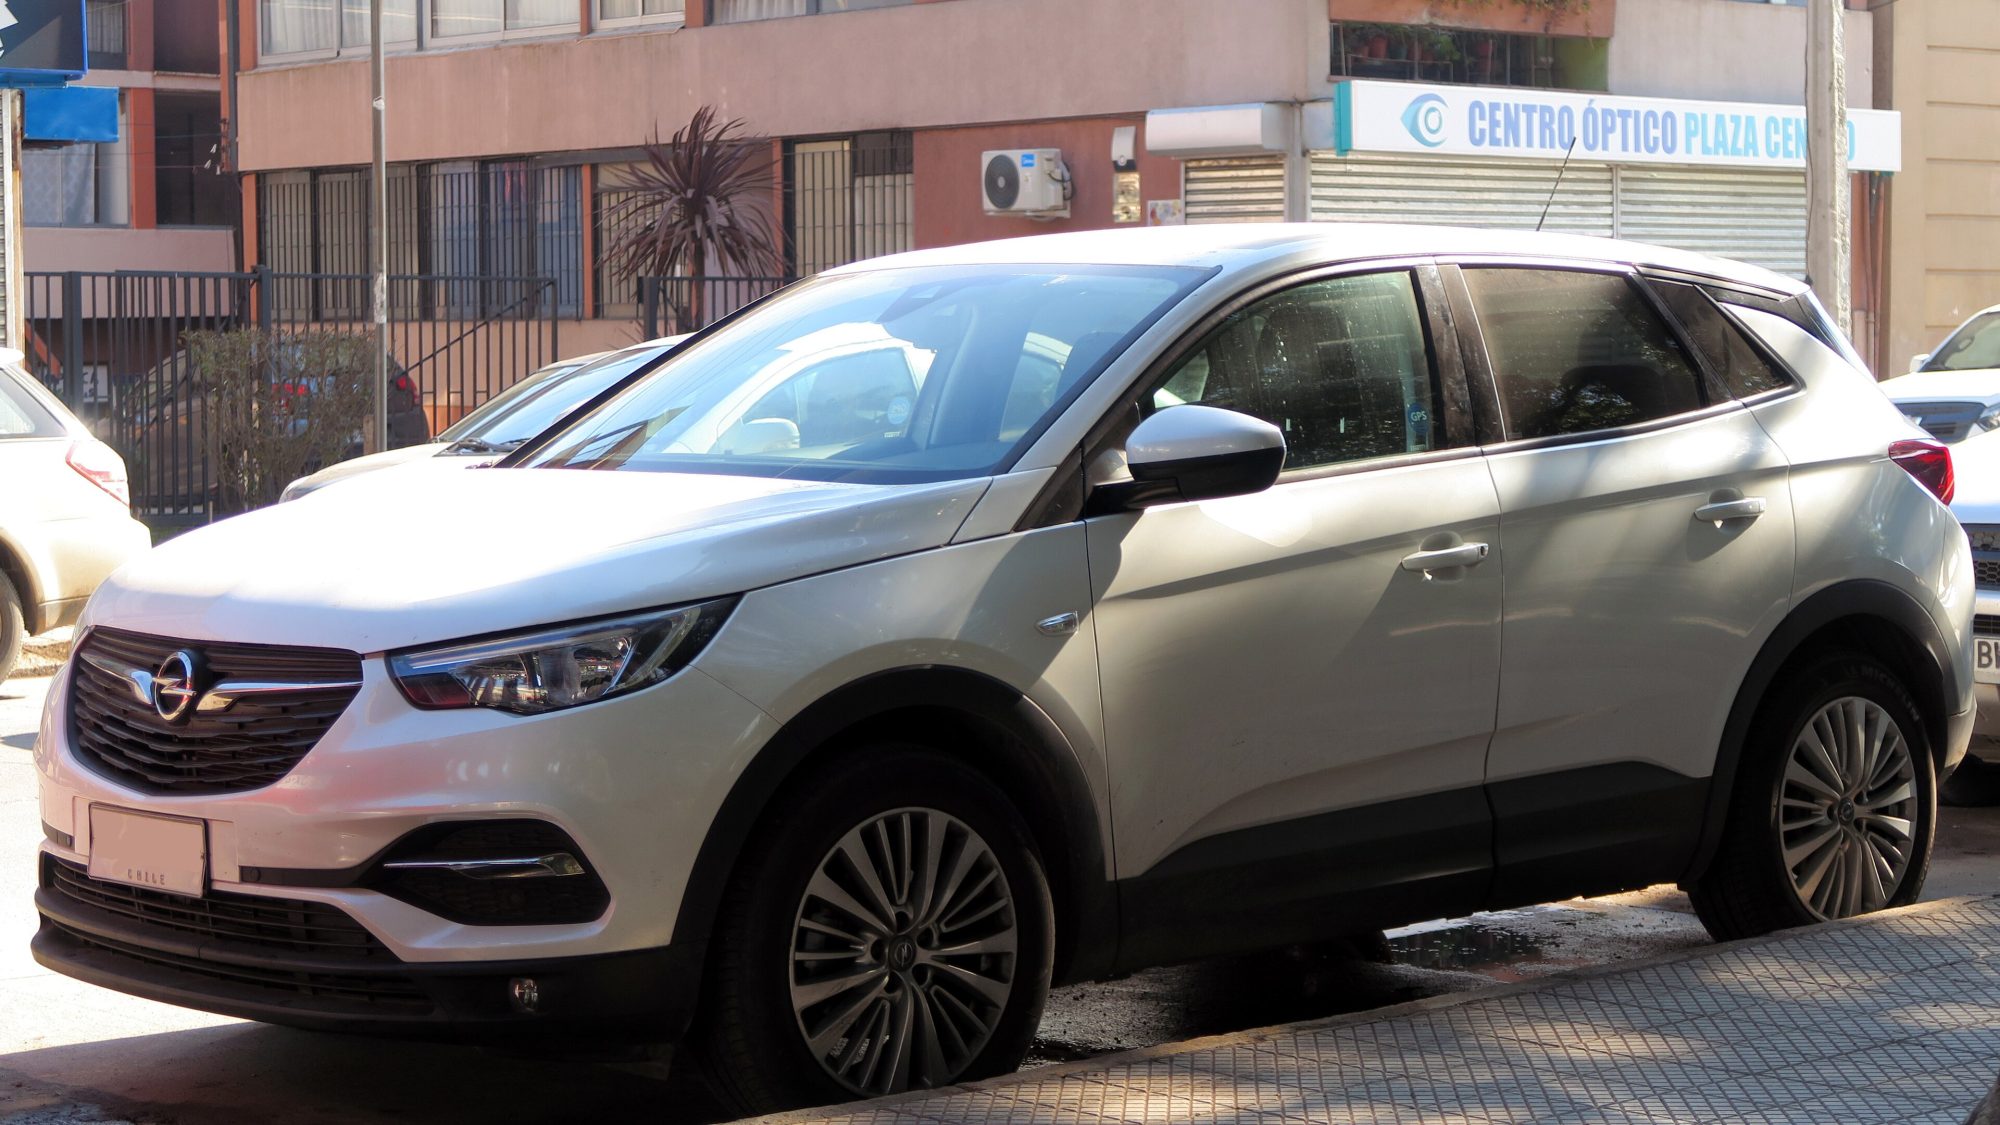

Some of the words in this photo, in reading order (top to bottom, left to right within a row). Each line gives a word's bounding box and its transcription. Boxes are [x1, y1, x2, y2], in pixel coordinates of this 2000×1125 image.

[1468, 100, 1575, 150] CENTRO
[1582, 98, 1678, 154] ÓPTICO
[1684, 112, 1759, 157] PLAZA
[1410, 411, 1427, 421] GPS
[127, 868, 165, 885] CHILE
